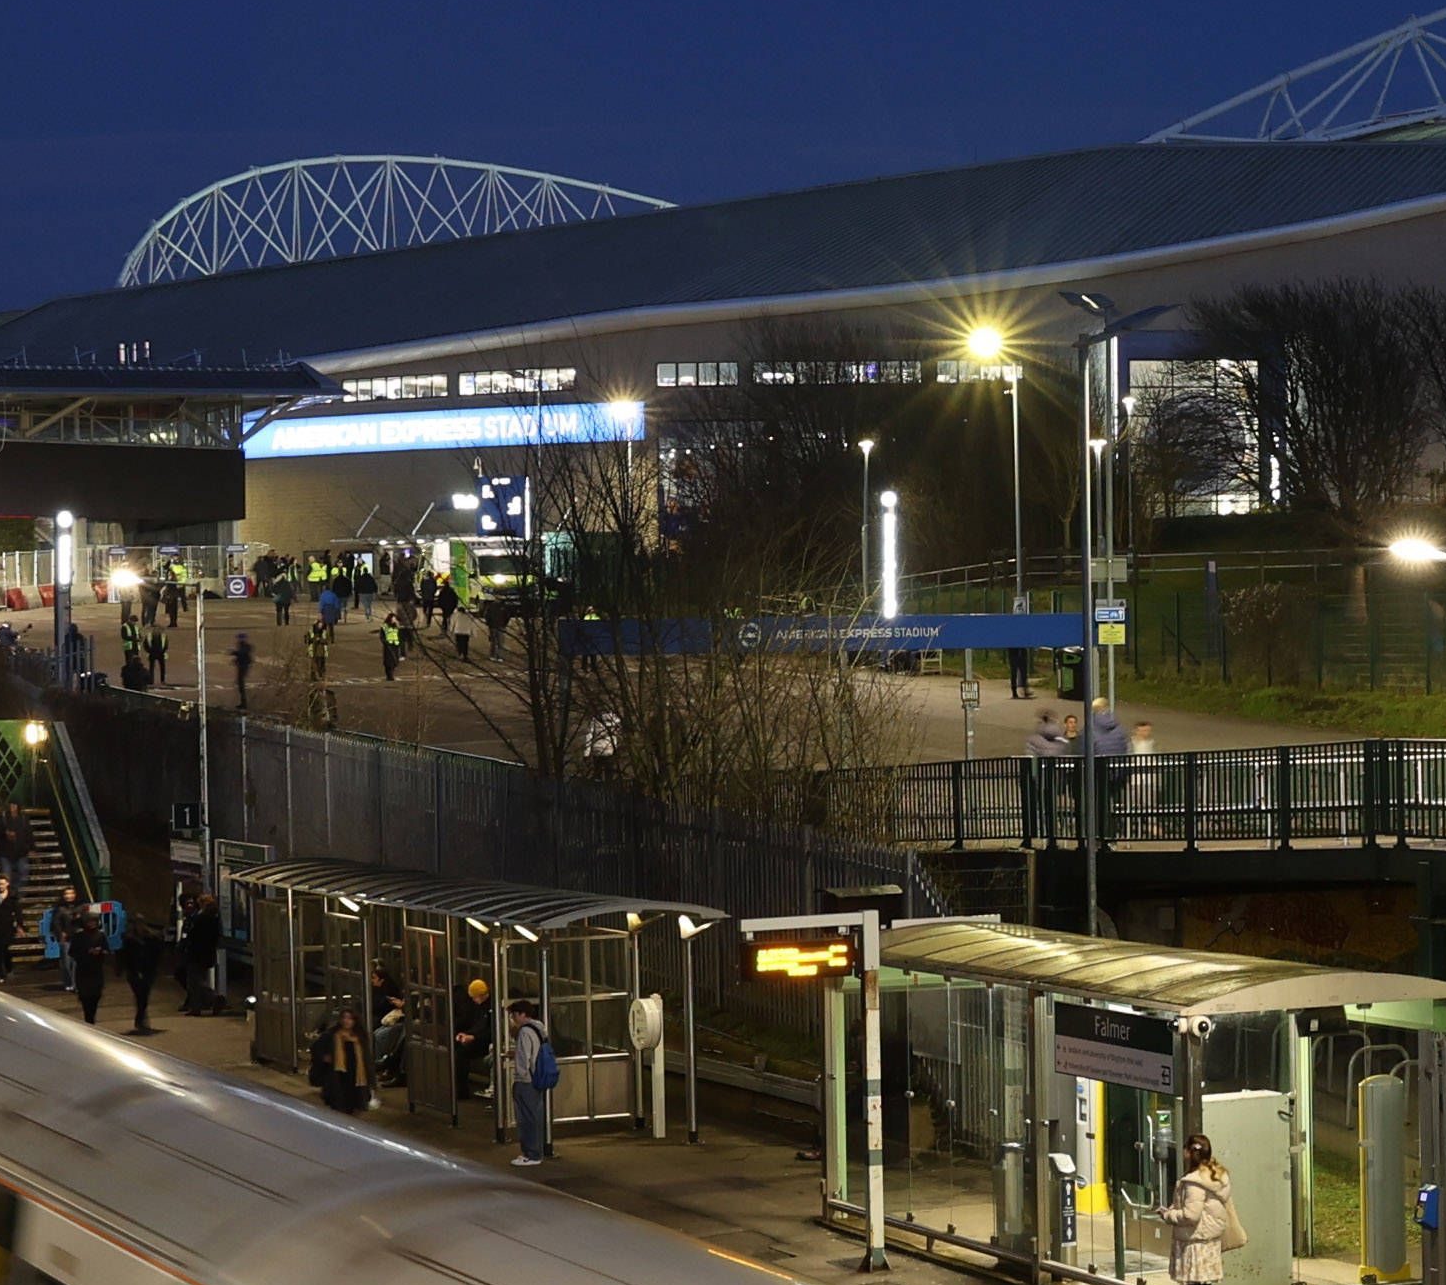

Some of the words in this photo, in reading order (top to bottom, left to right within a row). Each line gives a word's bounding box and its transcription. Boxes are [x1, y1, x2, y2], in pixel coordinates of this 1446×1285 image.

[271, 421, 376, 450] AMERICAN
[380, 418, 481, 446] EXPRESS
[485, 413, 577, 439] STADUM
[839, 627, 893, 639] EXPRESS
[894, 626, 939, 638] STADIUM
[184, 807, 190, 826] 1
[1094, 1015, 1131, 1041] Falmer
